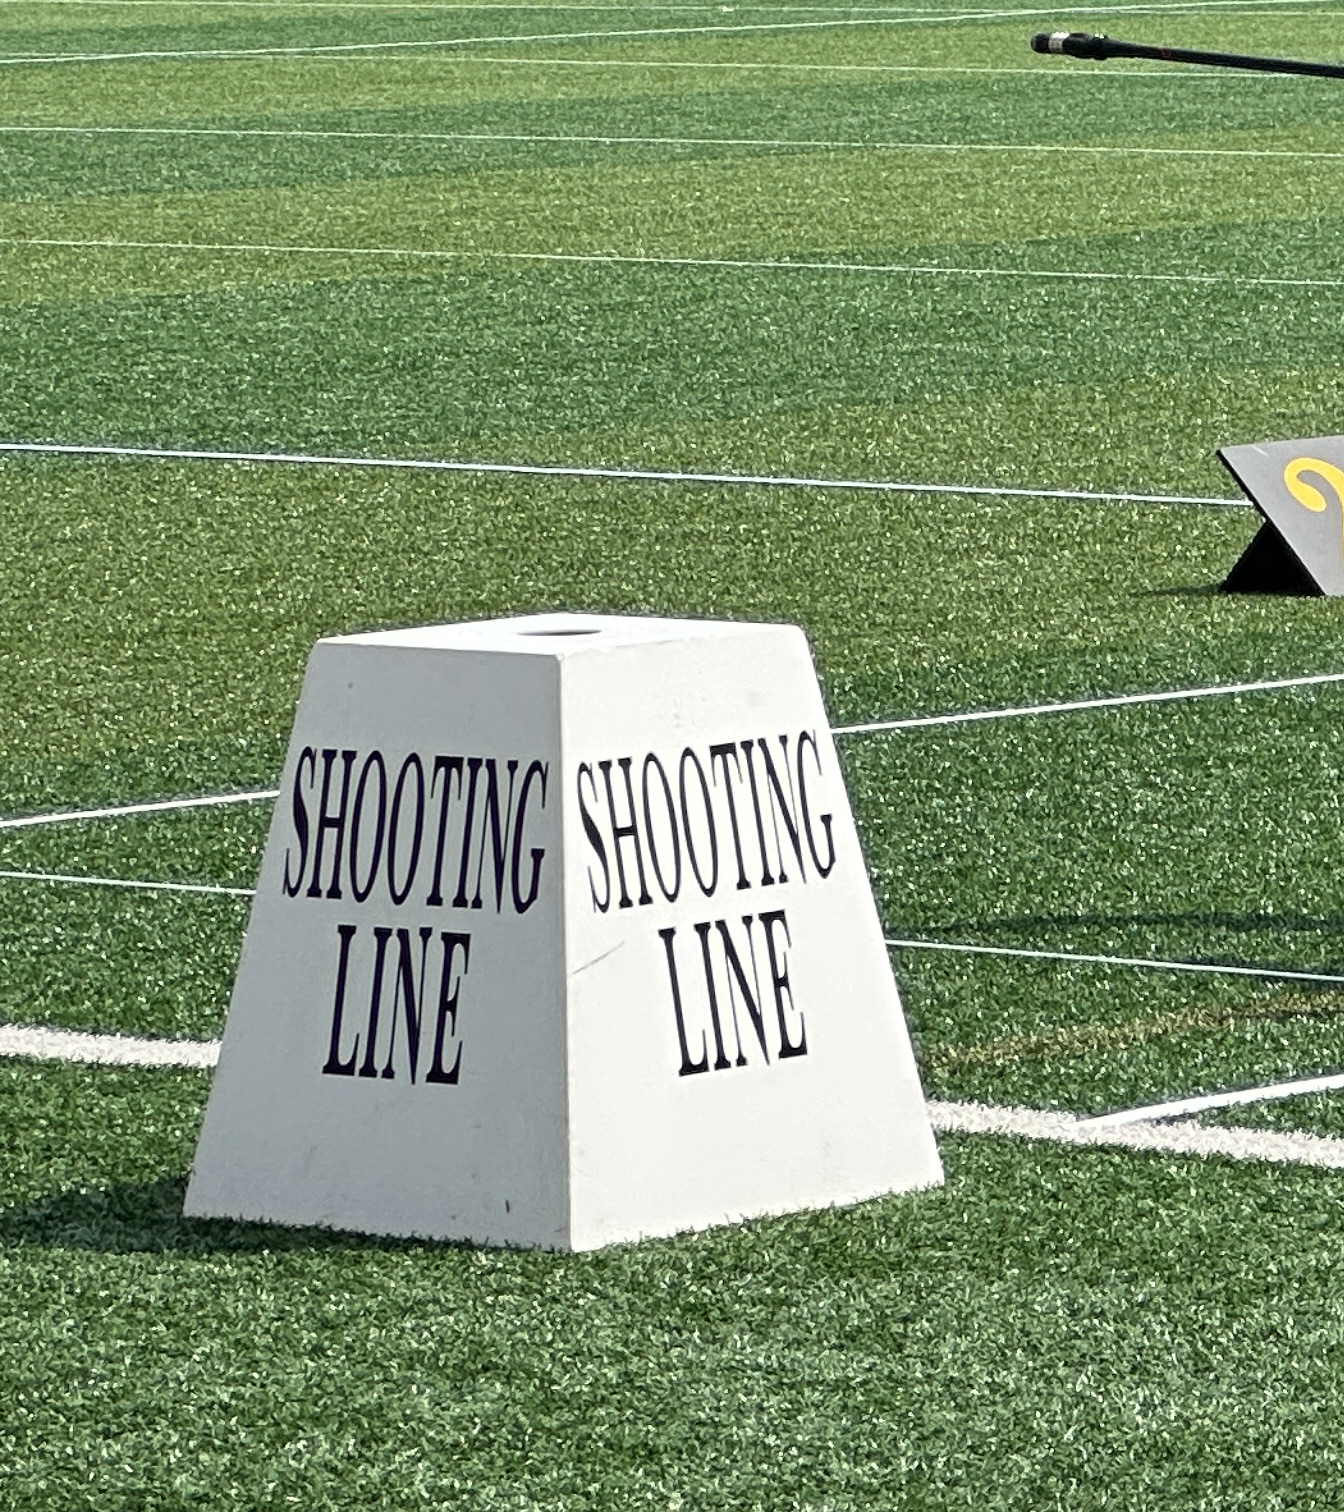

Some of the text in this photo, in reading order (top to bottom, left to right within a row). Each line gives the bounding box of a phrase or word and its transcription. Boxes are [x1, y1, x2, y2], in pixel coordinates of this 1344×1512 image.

[282, 746, 549, 914] SHOOTING
[577, 729, 836, 913] SHOOTING
[322, 925, 471, 1085] LINE
[658, 909, 808, 1077] LINE
